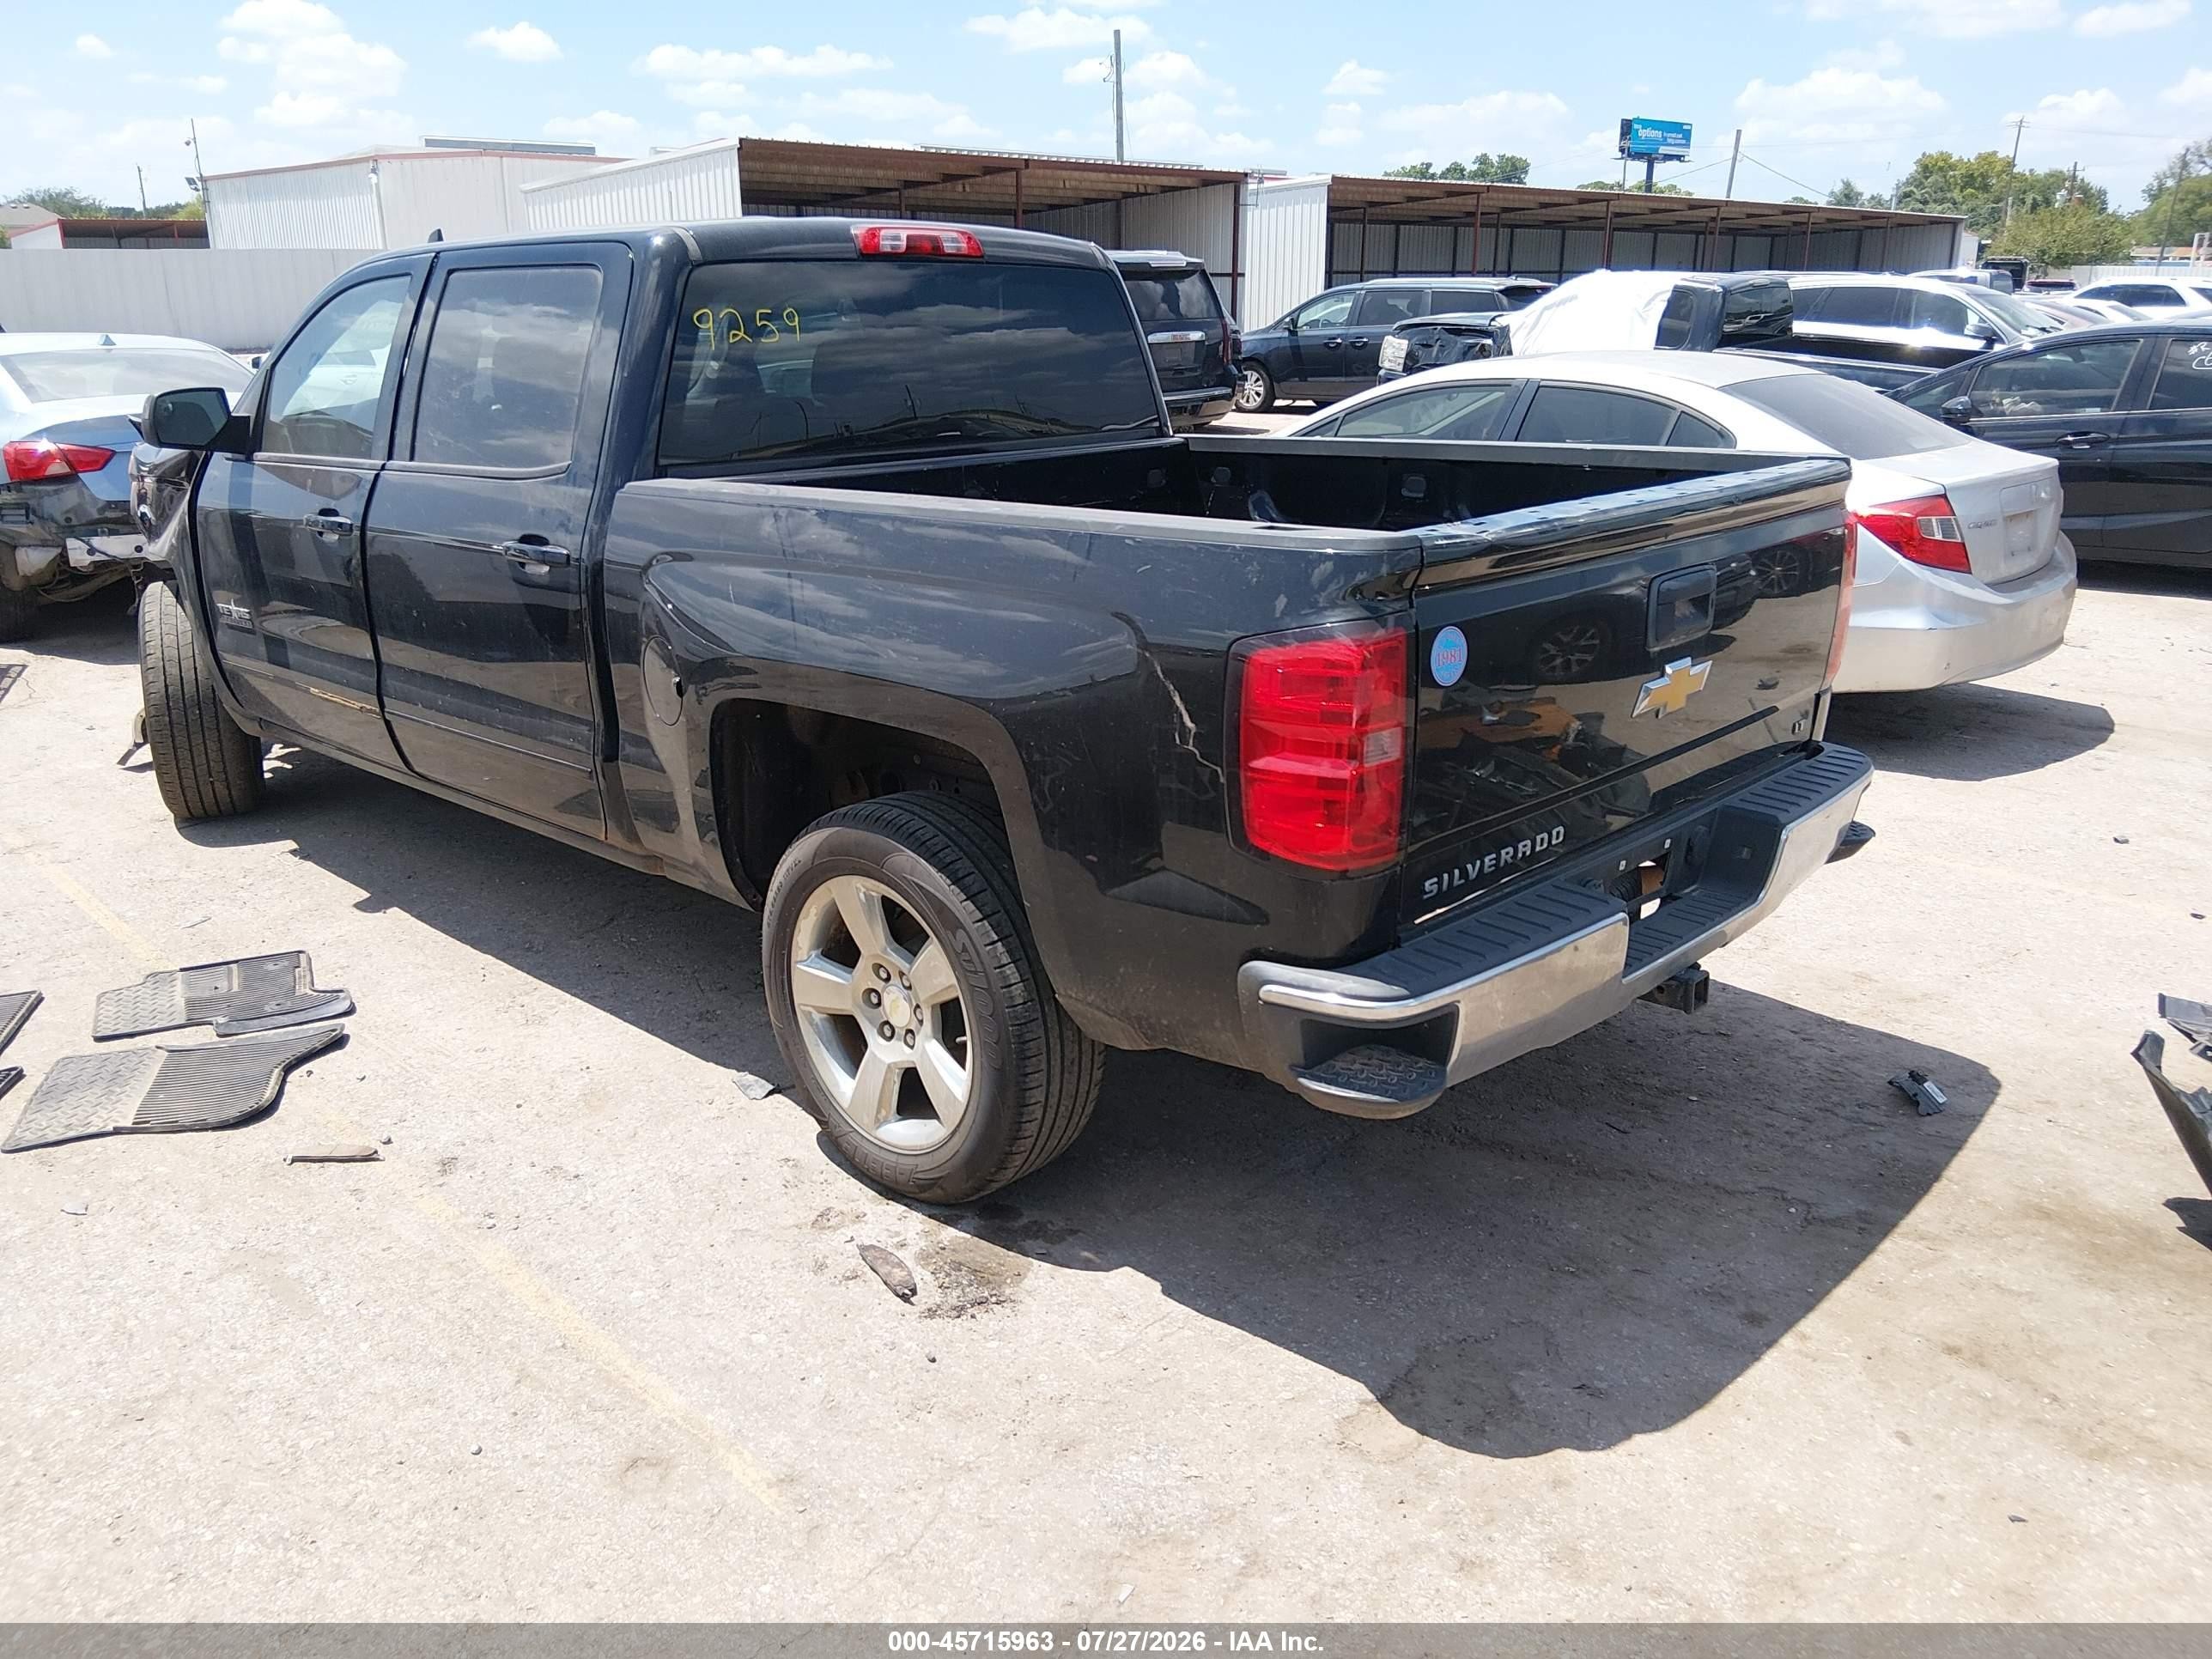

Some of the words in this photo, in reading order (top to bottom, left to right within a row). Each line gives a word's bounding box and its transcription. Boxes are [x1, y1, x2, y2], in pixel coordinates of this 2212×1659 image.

[1638, 128, 1662, 138] options
[693, 307, 800, 350] 9259
[216, 599, 251, 619] TEXAS
[1436, 647, 1462, 667] 1981
[1423, 826, 1565, 899] SILVERADO
